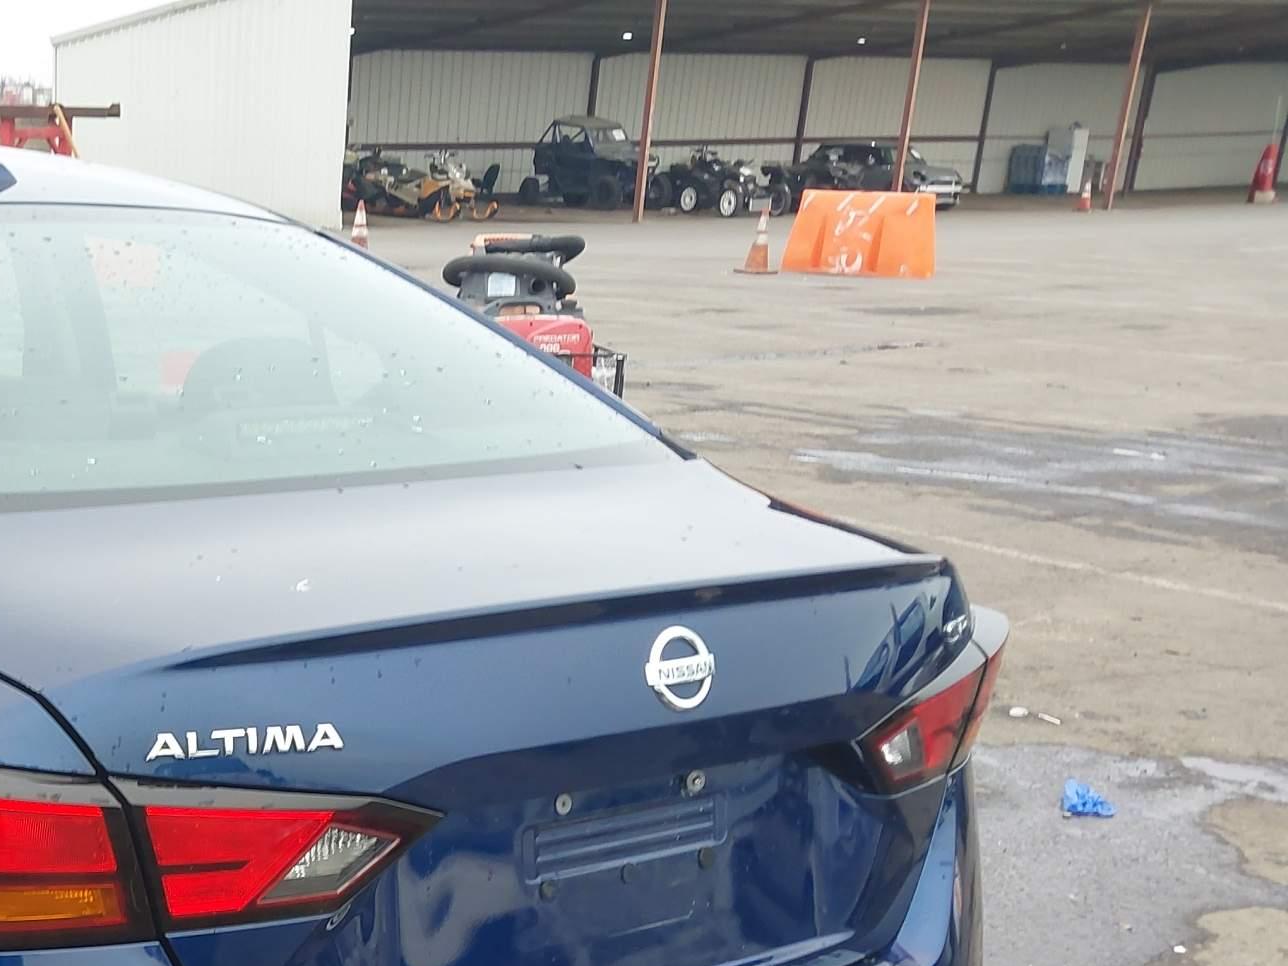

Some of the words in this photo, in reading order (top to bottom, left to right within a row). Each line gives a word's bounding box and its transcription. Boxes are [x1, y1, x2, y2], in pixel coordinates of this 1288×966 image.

[533, 333, 580, 344] PREDATOR
[657, 659, 713, 681] NISSAN
[145, 722, 345, 763] ALTIMA
